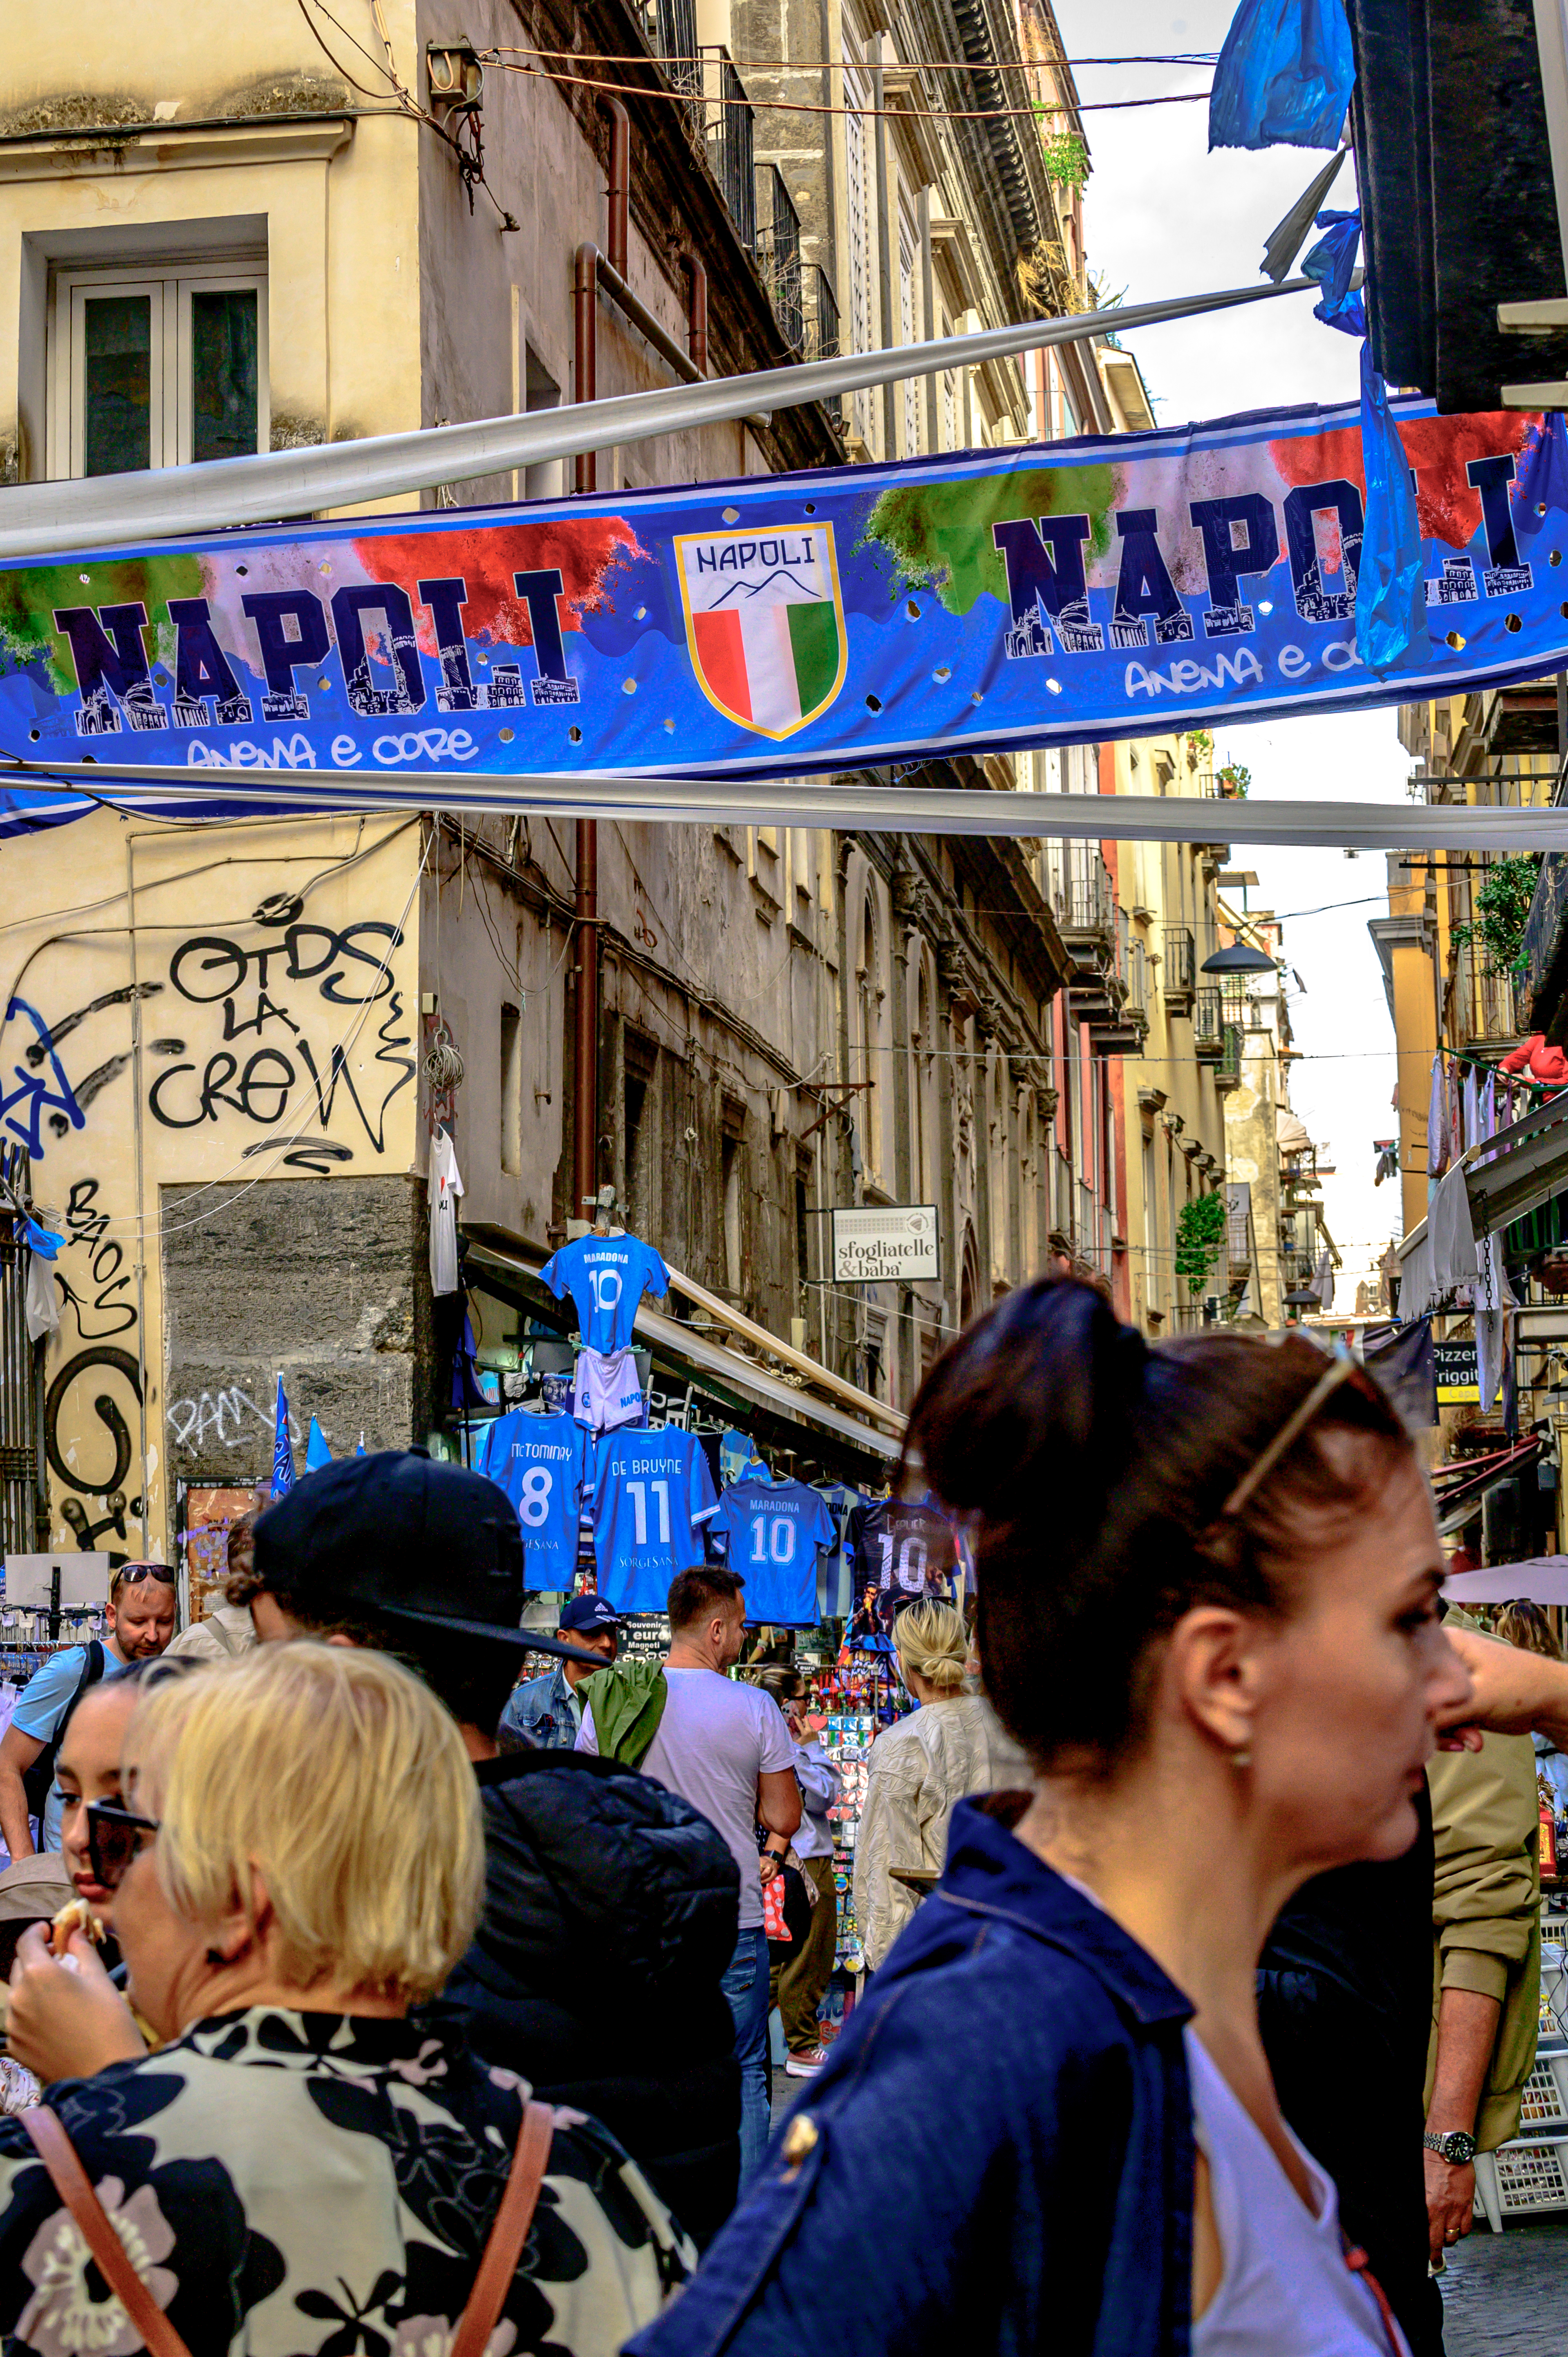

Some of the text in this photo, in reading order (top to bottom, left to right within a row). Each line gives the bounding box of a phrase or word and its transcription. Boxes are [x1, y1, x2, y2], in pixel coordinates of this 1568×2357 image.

[697, 537, 815, 573] NAPOLI
[53, 569, 580, 736] NAPOLI
[1279, 644, 1310, 678] e
[332, 735, 362, 765] e
[223, 992, 300, 1041] LA
[584, 1252, 629, 1264] MARADONA
[838, 1239, 934, 1264] sfogliatelle
[589, 1269, 623, 1313] 10
[1435, 1368, 1479, 1385] riggit
[612, 1458, 682, 1476] DE BRUYNE
[520, 1466, 553, 1527] 8
[626, 1480, 670, 1545] 11
[750, 1499, 800, 1513] MARADONA
[749, 1513, 796, 1566] 10
[878, 1533, 927, 1593] 10
[620, 1629, 627, 1640] 1
[627, 1621, 662, 1629] Souvenir
[628, 1641, 660, 1650] Magneti
